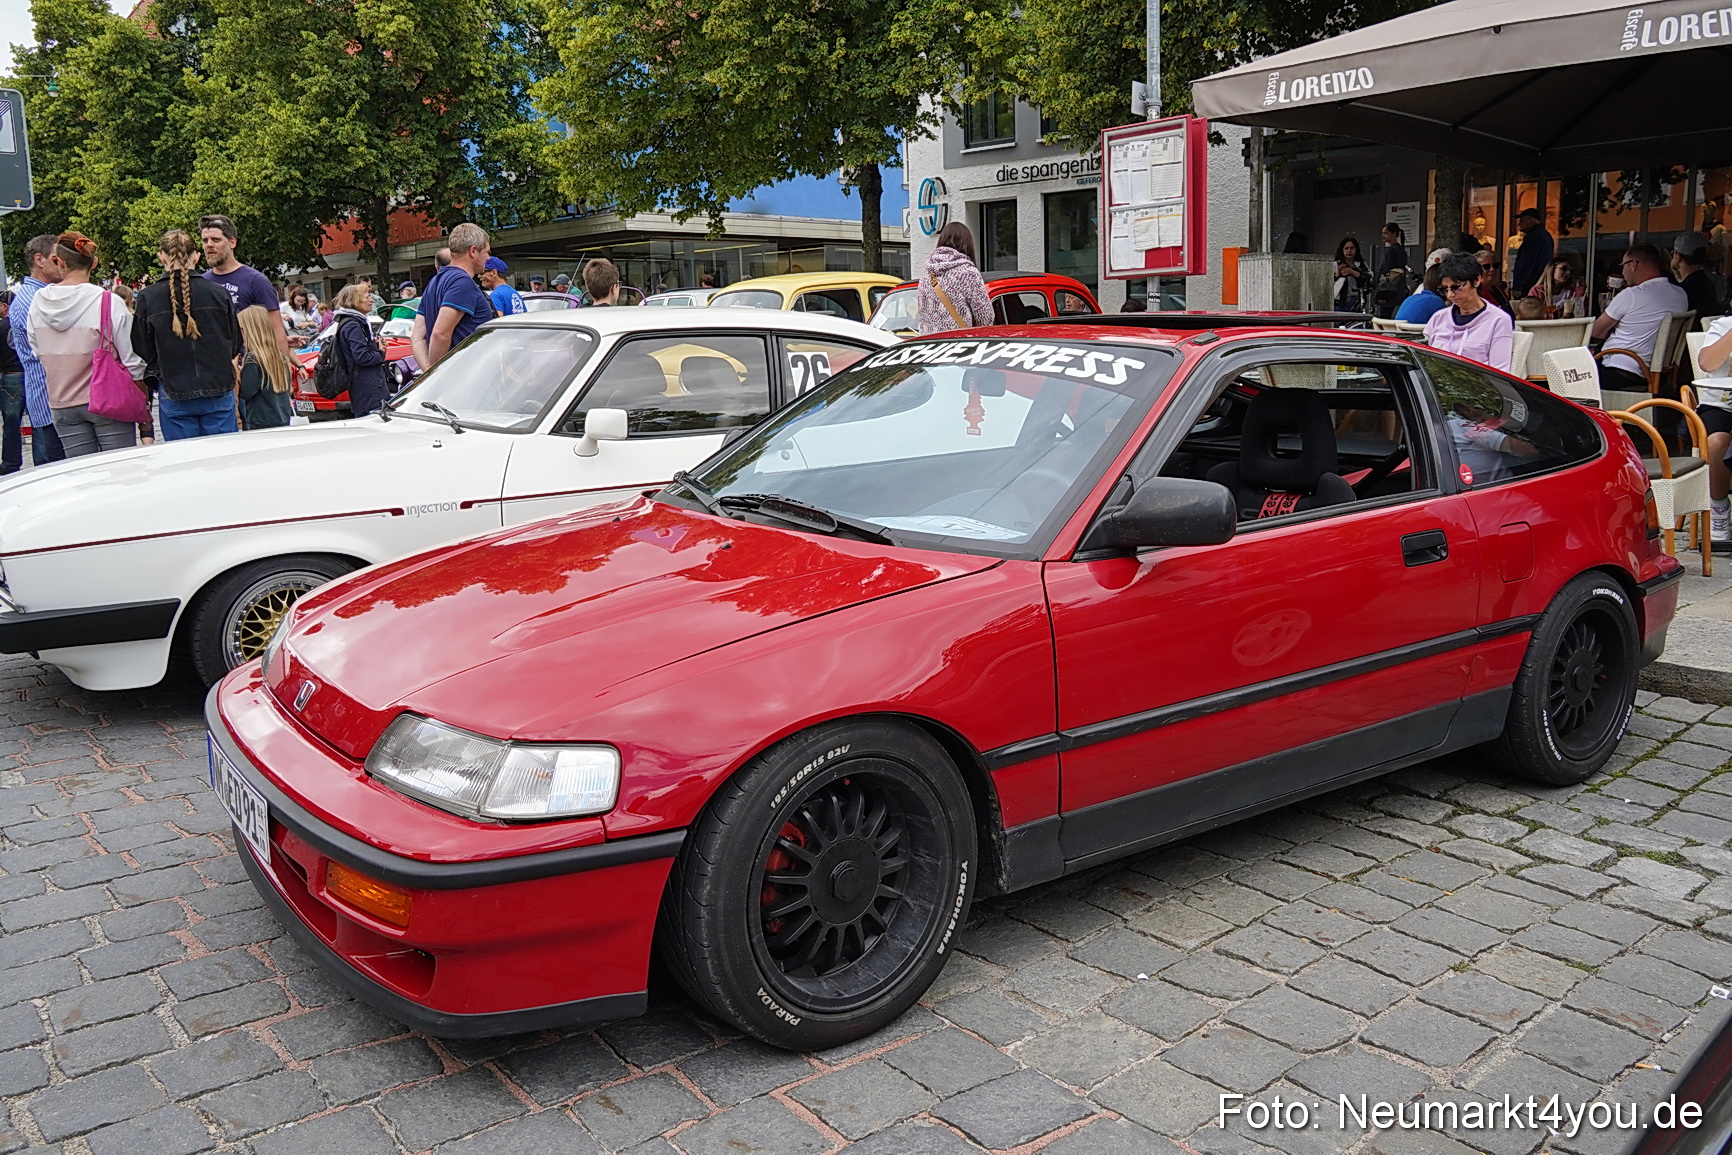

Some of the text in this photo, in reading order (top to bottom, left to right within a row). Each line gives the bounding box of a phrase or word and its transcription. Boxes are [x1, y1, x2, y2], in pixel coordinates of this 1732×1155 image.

[1279, 66, 1374, 103] LORENZO
[996, 165, 1019, 182] die
[849, 341, 1145, 385] SUSHIEXPRESS
[1592, 588, 1623, 604] YOKOHAMA
[770, 744, 851, 809] 195/50R15 82V
[936, 860, 969, 955] YOKOHAMA
[756, 987, 802, 1026] PARADA
